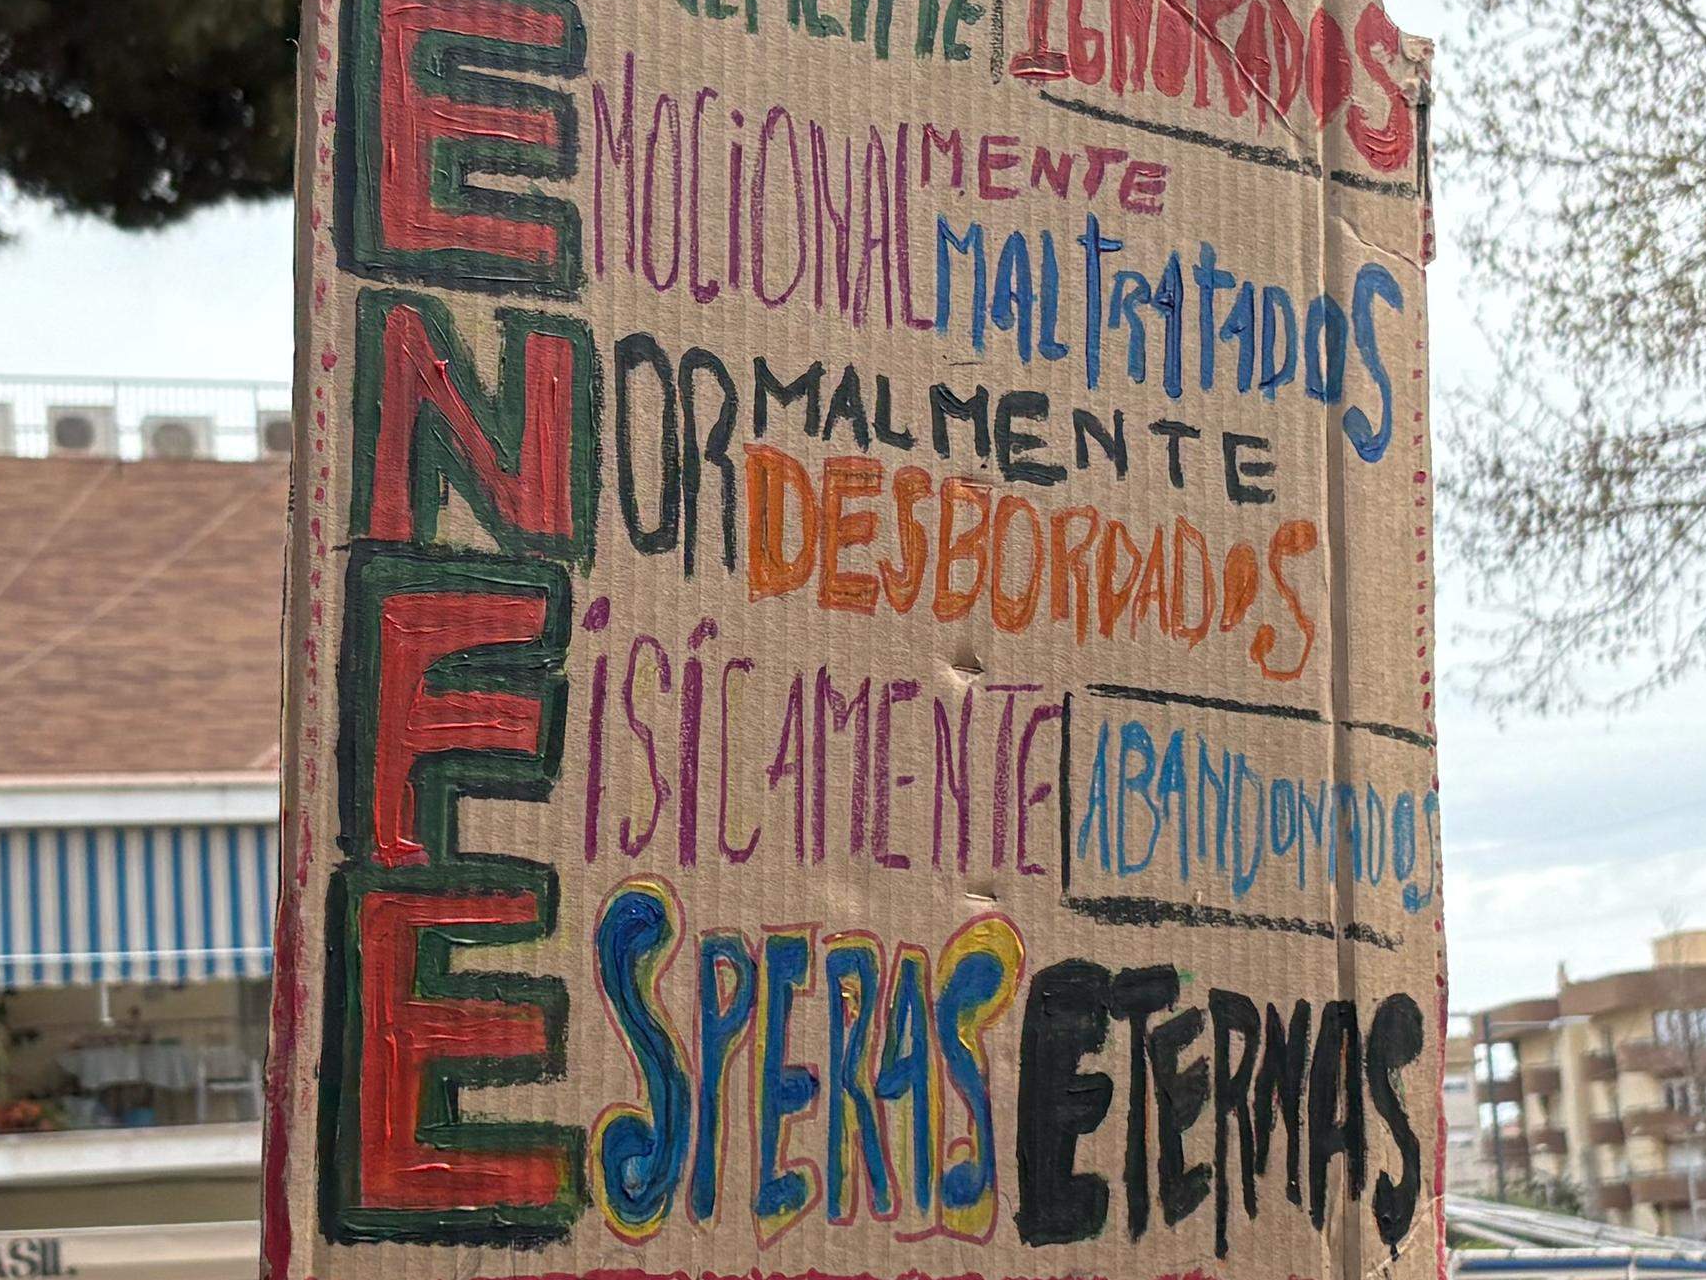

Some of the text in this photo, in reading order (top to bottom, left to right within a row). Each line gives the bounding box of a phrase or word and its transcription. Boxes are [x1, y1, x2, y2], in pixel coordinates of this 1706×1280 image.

[936, 210, 1404, 464] MALTRATADOS
[744, 442, 1319, 682] DESBORDADOS
[1076, 720, 1440, 915] ABANDONADOS
[1012, 956, 1425, 1262] ETERNAS
